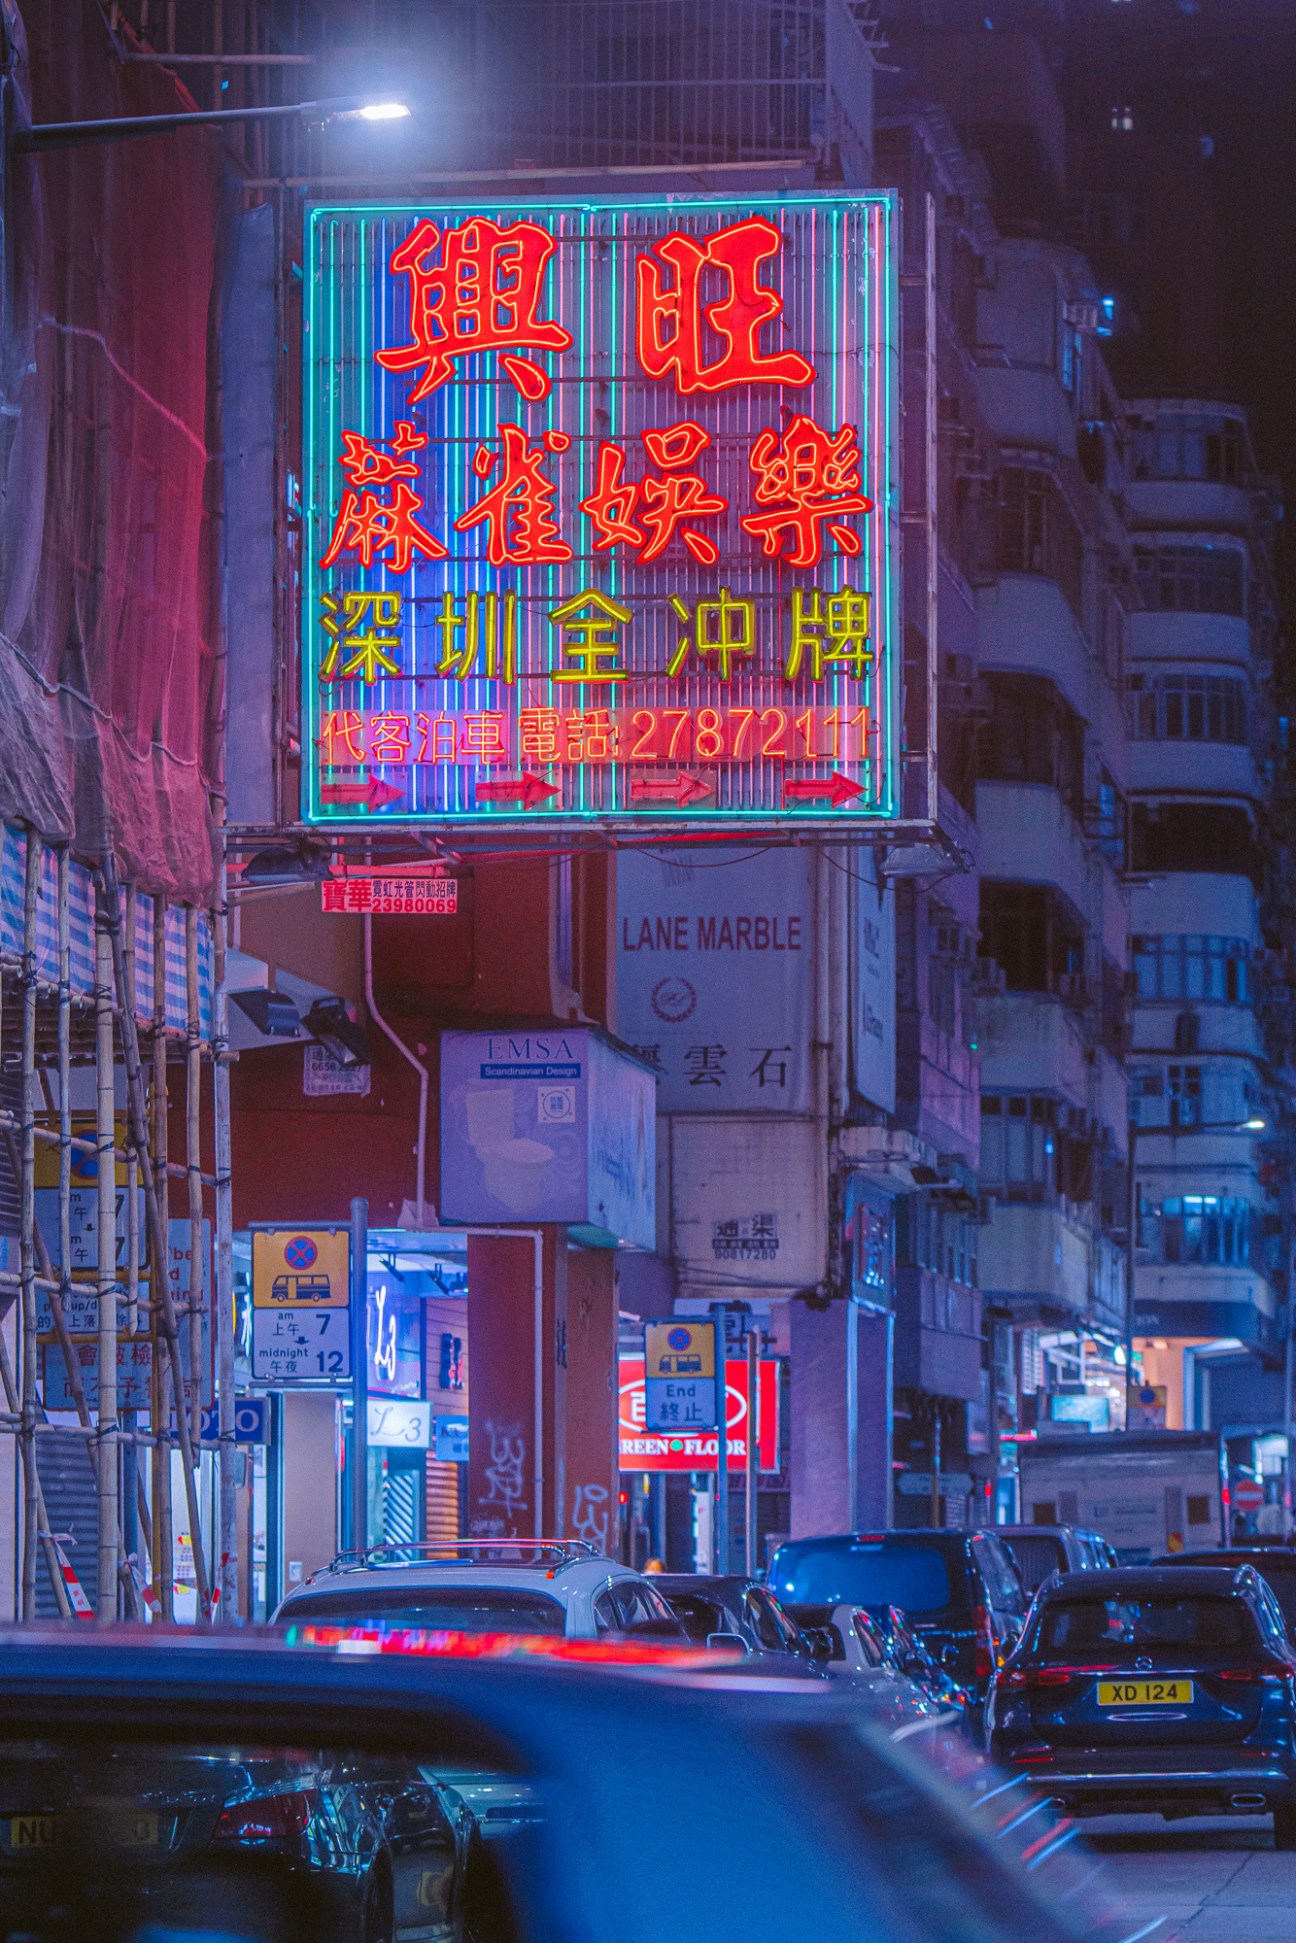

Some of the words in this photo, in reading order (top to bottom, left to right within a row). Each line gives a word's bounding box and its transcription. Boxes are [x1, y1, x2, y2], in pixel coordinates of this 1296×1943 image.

[322, 710, 505, 764] 代客泊車
[632, 708, 869, 758] 27872111
[323, 880, 372, 912] 寶華
[372, 899, 456, 913] 23980069
[623, 917, 688, 950] LANE
[697, 917, 801, 950] MARBLE
[488, 1038, 574, 1059] EMSA
[485, 1067, 543, 1076] Scandinavian
[546, 1066, 577, 1077] Design
[272, 1323, 300, 1336] 上午
[316, 1314, 331, 1335] 7
[278, 1312, 294, 1320] am
[259, 1348, 308, 1359] midnight
[270, 1360, 297, 1374] 午夜
[316, 1350, 344, 1373] 12
[666, 1384, 696, 1397] End
[660, 1402, 703, 1421] 終止
[619, 1439, 668, 1455] REEN
[1112, 1684, 1137, 1701] XD
[1146, 1683, 1178, 1700] 124
